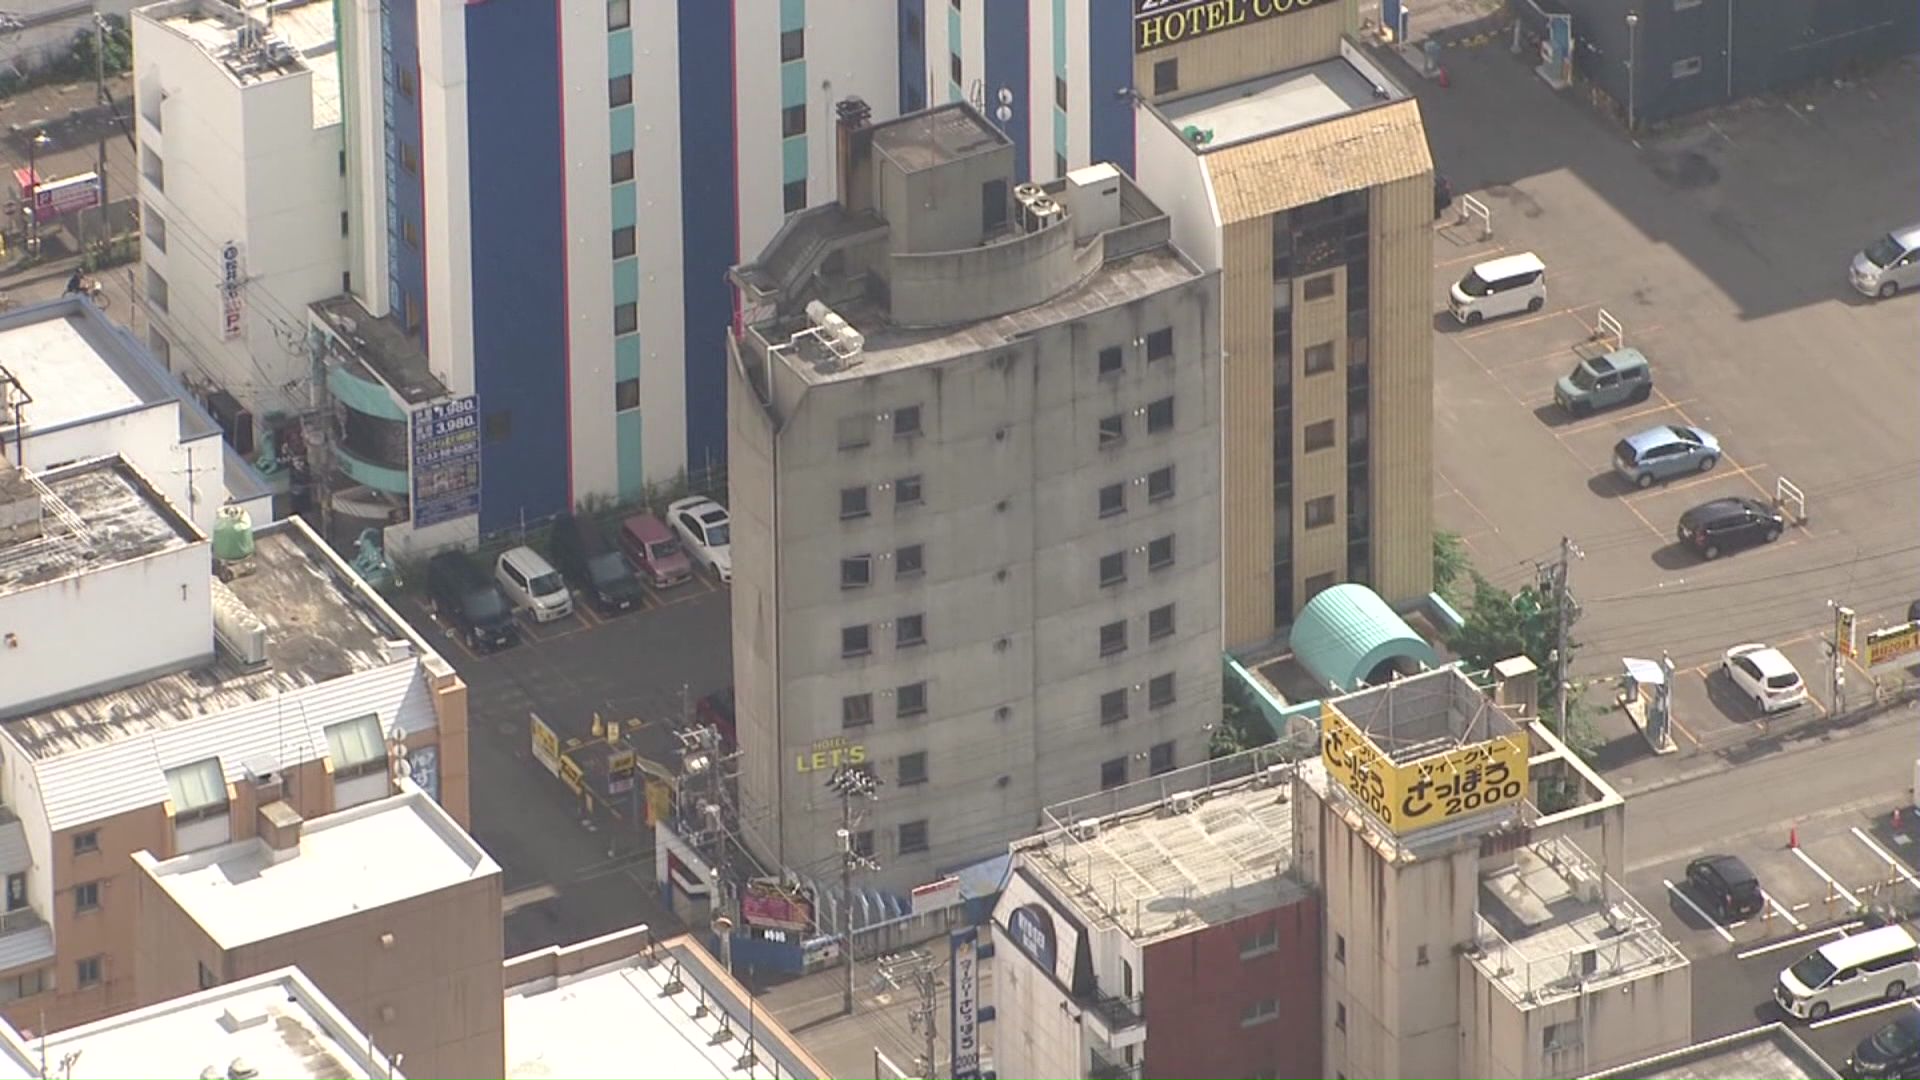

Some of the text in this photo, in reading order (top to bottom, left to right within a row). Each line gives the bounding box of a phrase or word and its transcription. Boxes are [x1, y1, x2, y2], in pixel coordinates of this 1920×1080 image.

[1141, 0, 1245, 48] HOTEL
[796, 745, 865, 773] LET'S
[1350, 775, 1393, 825] 2000
[1402, 761, 1510, 818] さっぽろ
[1445, 781, 1521, 817] 2000
